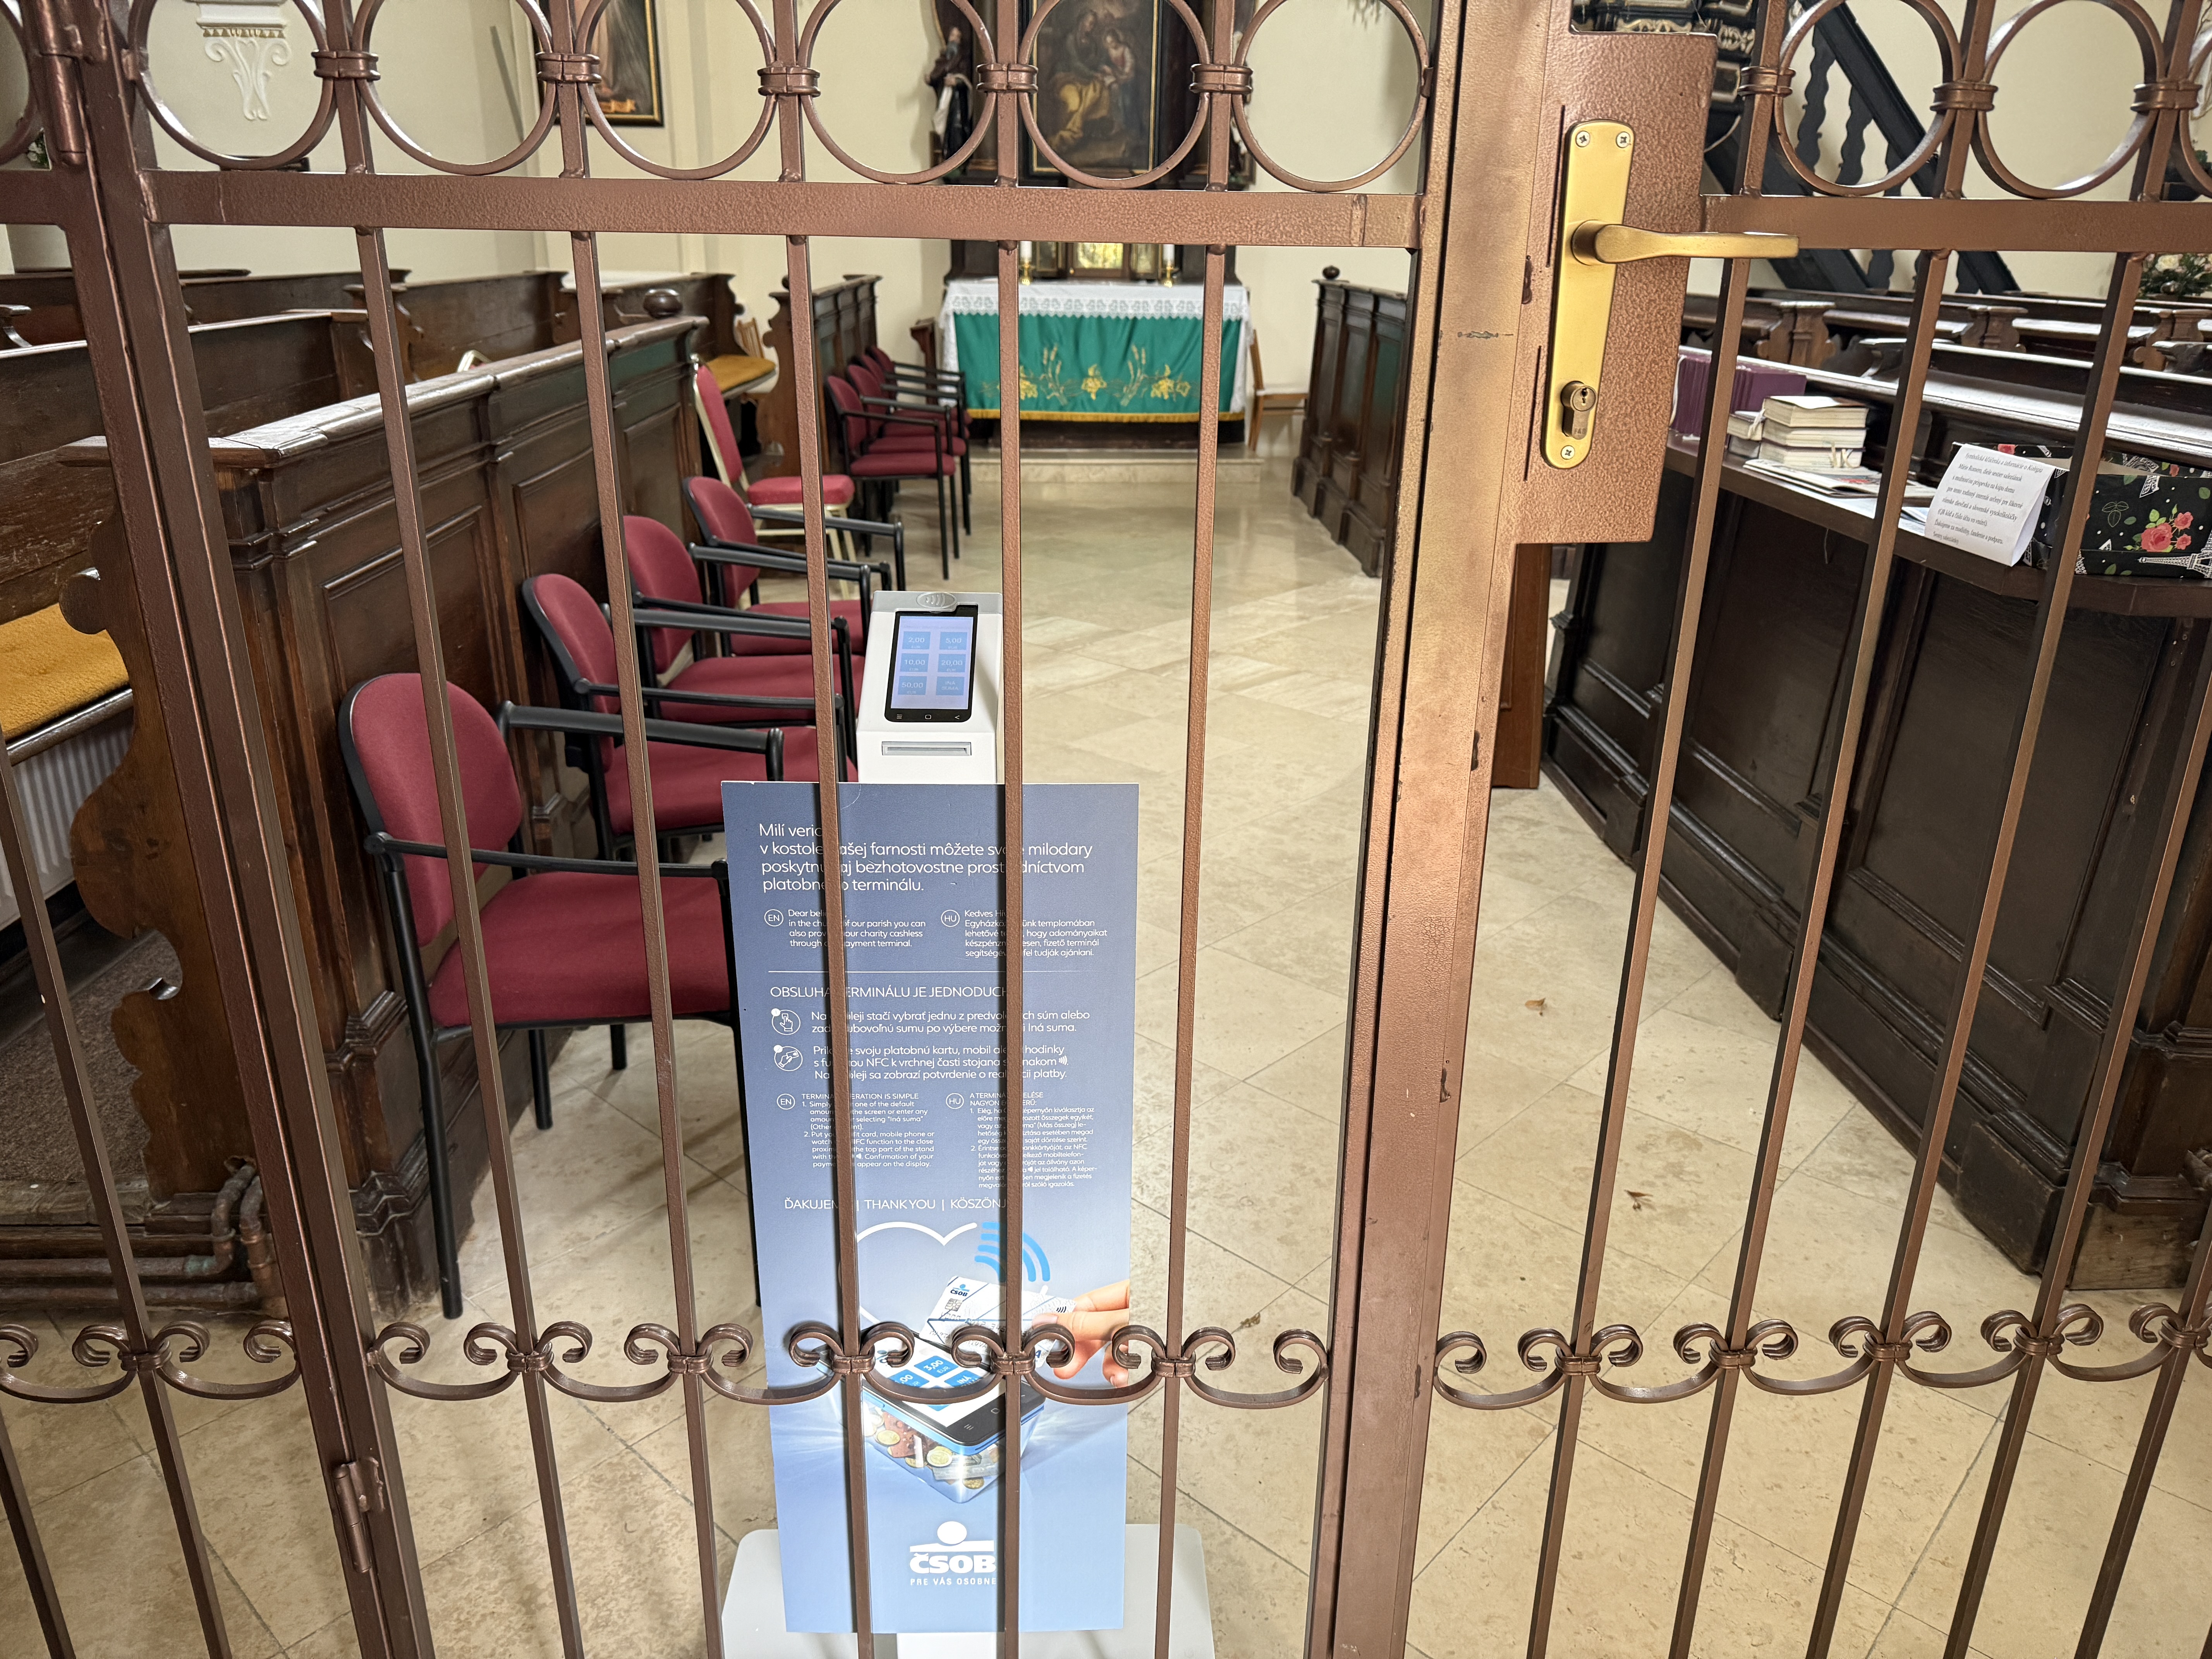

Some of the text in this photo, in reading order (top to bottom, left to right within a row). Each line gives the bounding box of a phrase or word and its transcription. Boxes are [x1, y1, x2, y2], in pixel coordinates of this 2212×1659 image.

[760, 823, 822, 836] Milí veria
[760, 845, 768, 854] v
[773, 842, 823, 854] kostole
[840, 842, 866, 858] ašej
[870, 842, 926, 855] farnosti
[931, 843, 984, 855] môžete
[1029, 842, 1092, 858] milodary
[762, 860, 823, 876] poskytn
[856, 860, 963, 873] bezhotovostne
[968, 860, 1084, 876] prostdníctvom
[852, 878, 924, 890] terminálu.
[867, 920, 892, 929] parish
[1038, 919, 1094, 929] templomában
[860, 929, 888, 939] charity
[890, 929, 923, 938] cashless
[1027, 929, 1048, 939] hogy
[1049, 929, 1108, 939] adományaikat
[790, 939, 822, 948] through
[1066, 938, 1099, 946] terminál
[1035, 949, 1059, 958] tudják
[1061, 949, 1094, 958] ajánlani.
[770, 985, 1006, 997] OBSLUHA ERMINÁLU JE JEDNODUCH
[812, 1012, 826, 1020] Na
[867, 1012, 890, 1020] stačí
[892, 1011, 926, 1022] vybrať
[927, 1011, 956, 1022] jednu
[967, 1011, 1034, 1022] predvolch
[1037, 1011, 1058, 1019] súm
[1061, 1010, 1090, 1019] alebo
[847, 1023, 893, 1033] ubovoľnú
[927, 1026, 940, 1034] po
[943, 1023, 978, 1034] výbere
[1029, 1022, 1044, 1031] Iná
[855, 1044, 1064, 1057] svoju platobnú kartu, mobil hodinky
[867, 1057, 889, 1067] NFC
[891, 1058, 897, 1066] k
[899, 1058, 934, 1068] vrchnej
[937, 1058, 960, 1066] časti
[963, 1058, 1000, 1069] stojana
[1022, 1057, 1056, 1065] nakom
[815, 1070, 829, 1079] Na
[883, 1070, 921, 1079] zobrazí
[923, 1070, 976, 1080] potvrdenie
[989, 1069, 1030, 1078] realcii
[1034, 1069, 1066, 1080] platby.
[978, 1144, 999, 1152] Érintse
[785, 1197, 1006, 1209] ĎAKUJEM THANK YOU KÖSZÖNJ
[923, 1360, 943, 1370] 3,00
[910, 1553, 996, 1573] ČSOB
[933, 1577, 952, 1585] VÁS
